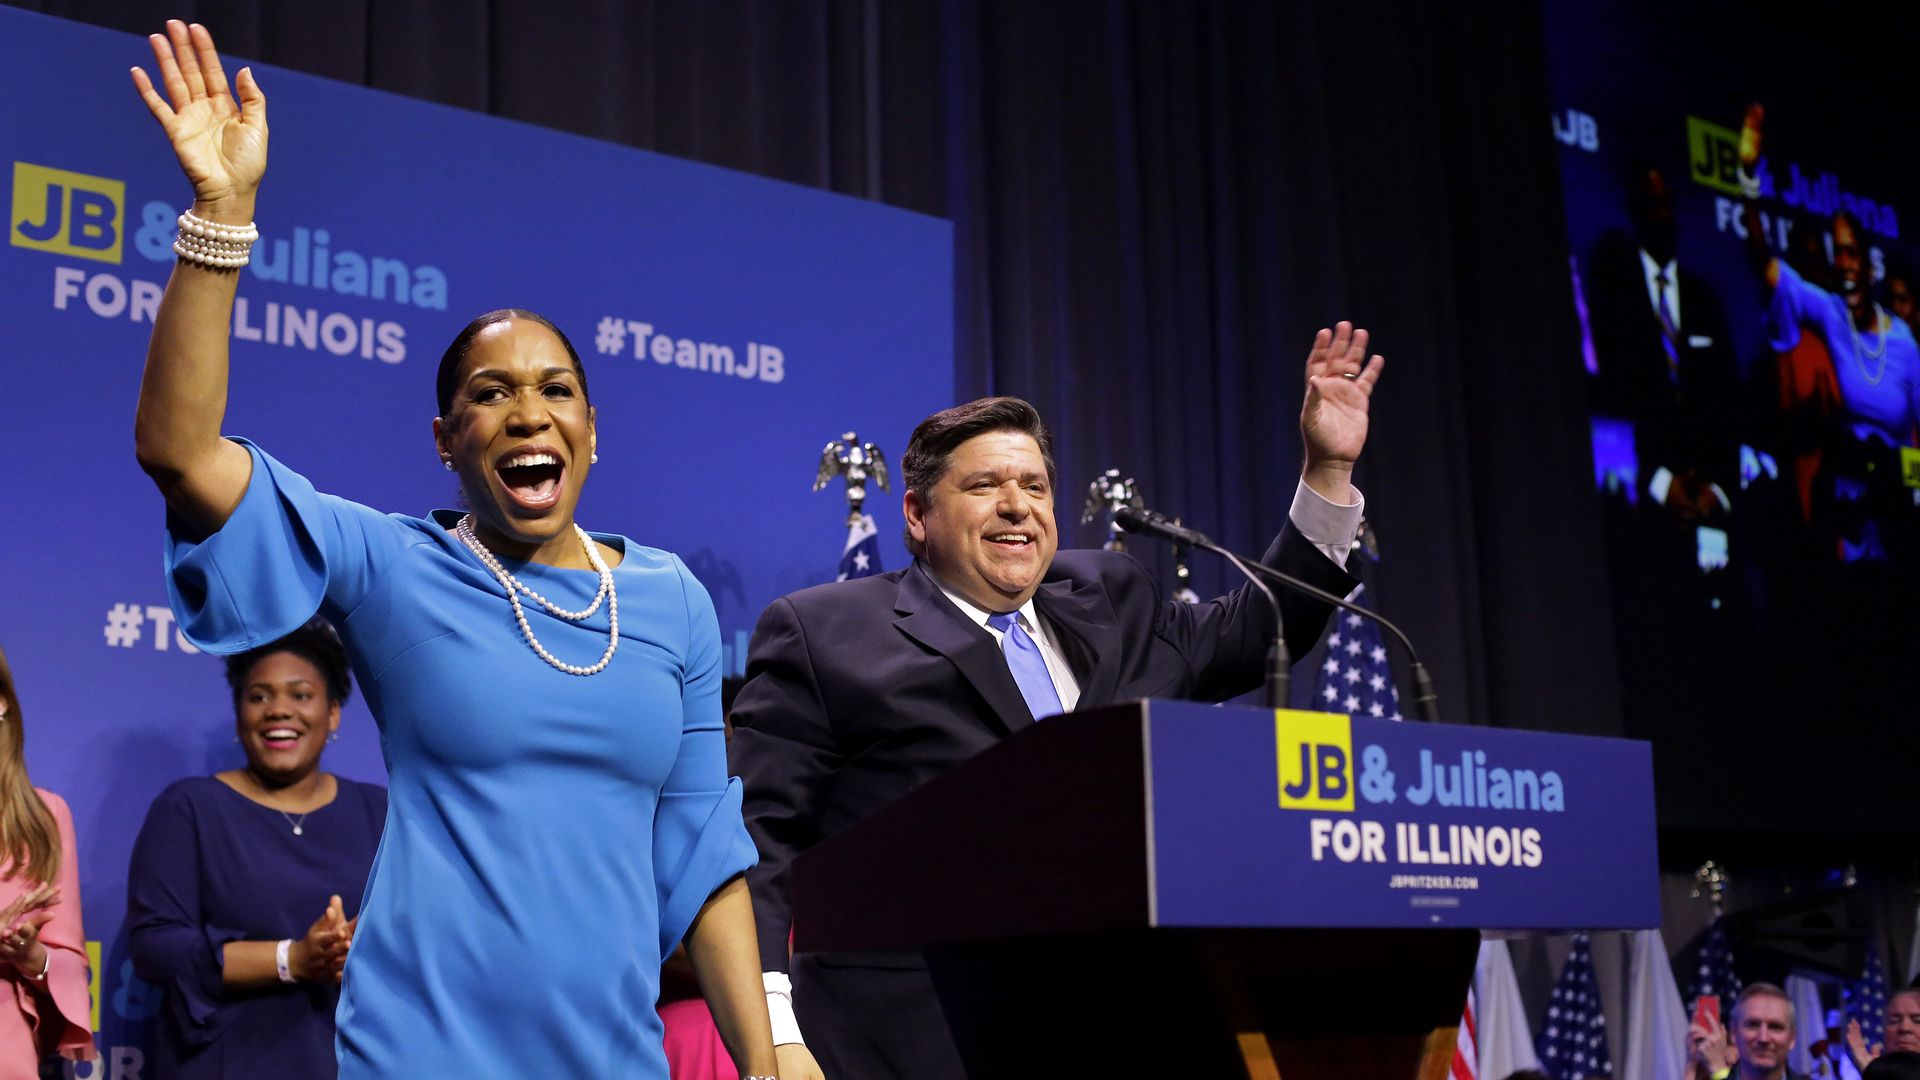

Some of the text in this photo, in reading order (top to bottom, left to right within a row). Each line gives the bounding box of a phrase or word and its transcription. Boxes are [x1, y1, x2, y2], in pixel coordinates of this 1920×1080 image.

[16, 182, 447, 310] JB & uliana
[53, 267, 407, 364] FOR LINOIS
[595, 316, 785, 383] #TeamJB
[1284, 742, 1565, 811] JB & Juliana
[1310, 818, 1543, 868] FOR ILLINOIS
[1389, 875, 1478, 889] JBPRITZKER.COM
